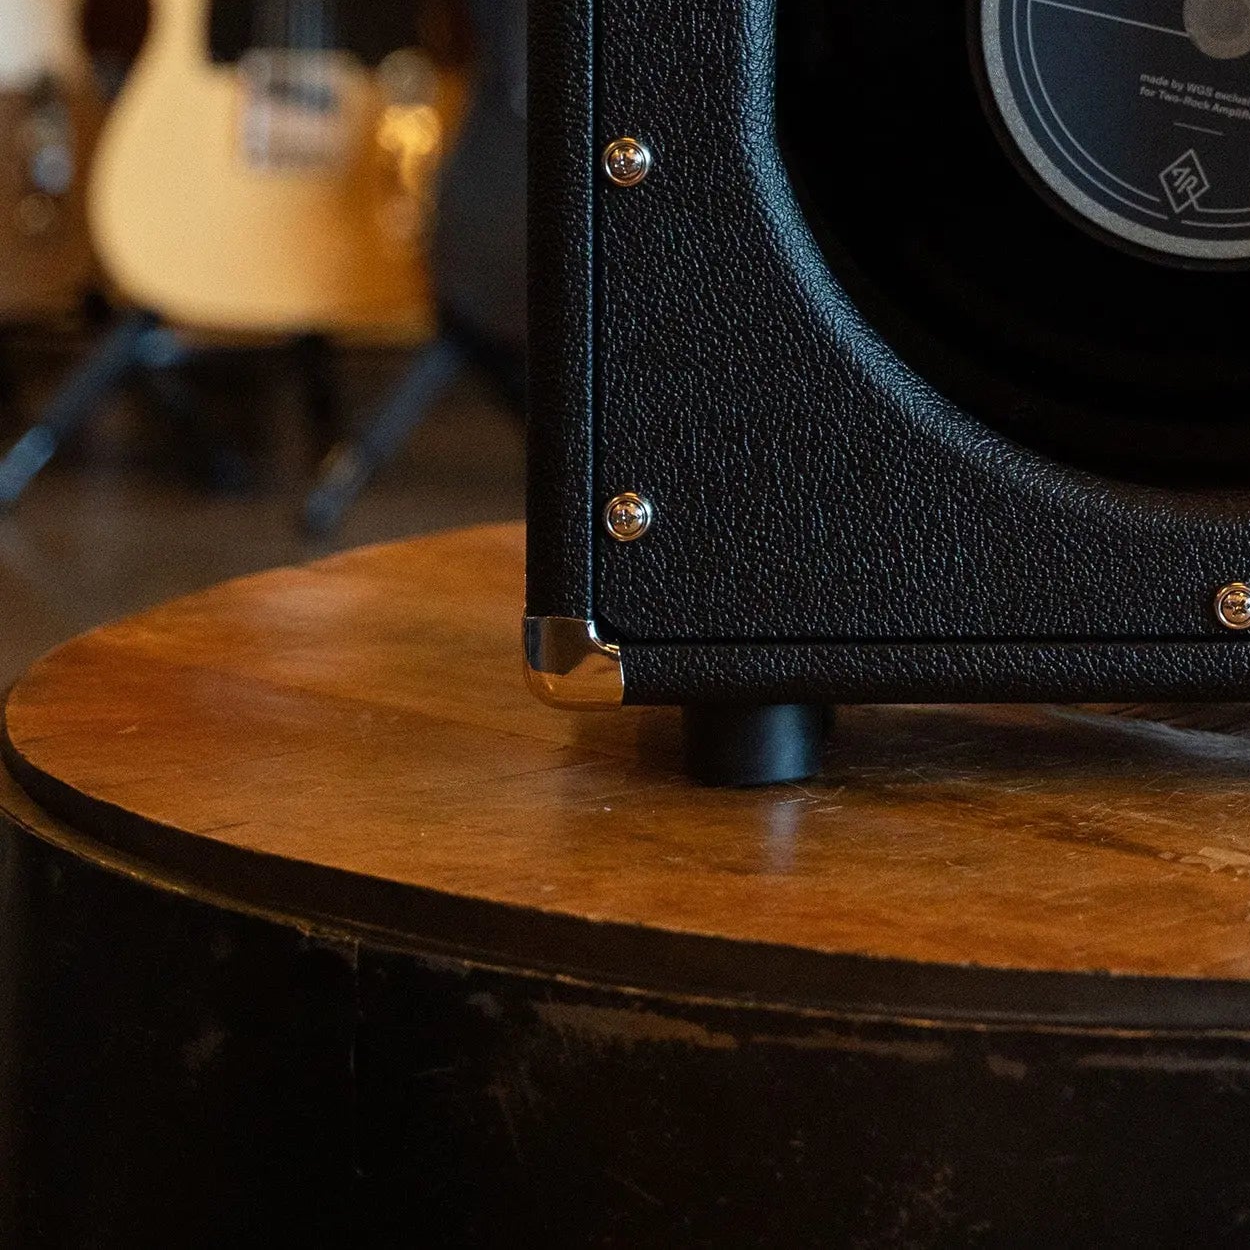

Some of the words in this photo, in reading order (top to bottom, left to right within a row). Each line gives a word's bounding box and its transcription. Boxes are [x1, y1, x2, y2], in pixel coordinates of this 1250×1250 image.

[1139, 73, 1169, 87] made
[1170, 78, 1185, 92] by
[1186, 82, 1214, 98] WGS
[1139, 86, 1157, 98] for
[1158, 89, 1211, 110] Two-Rock
